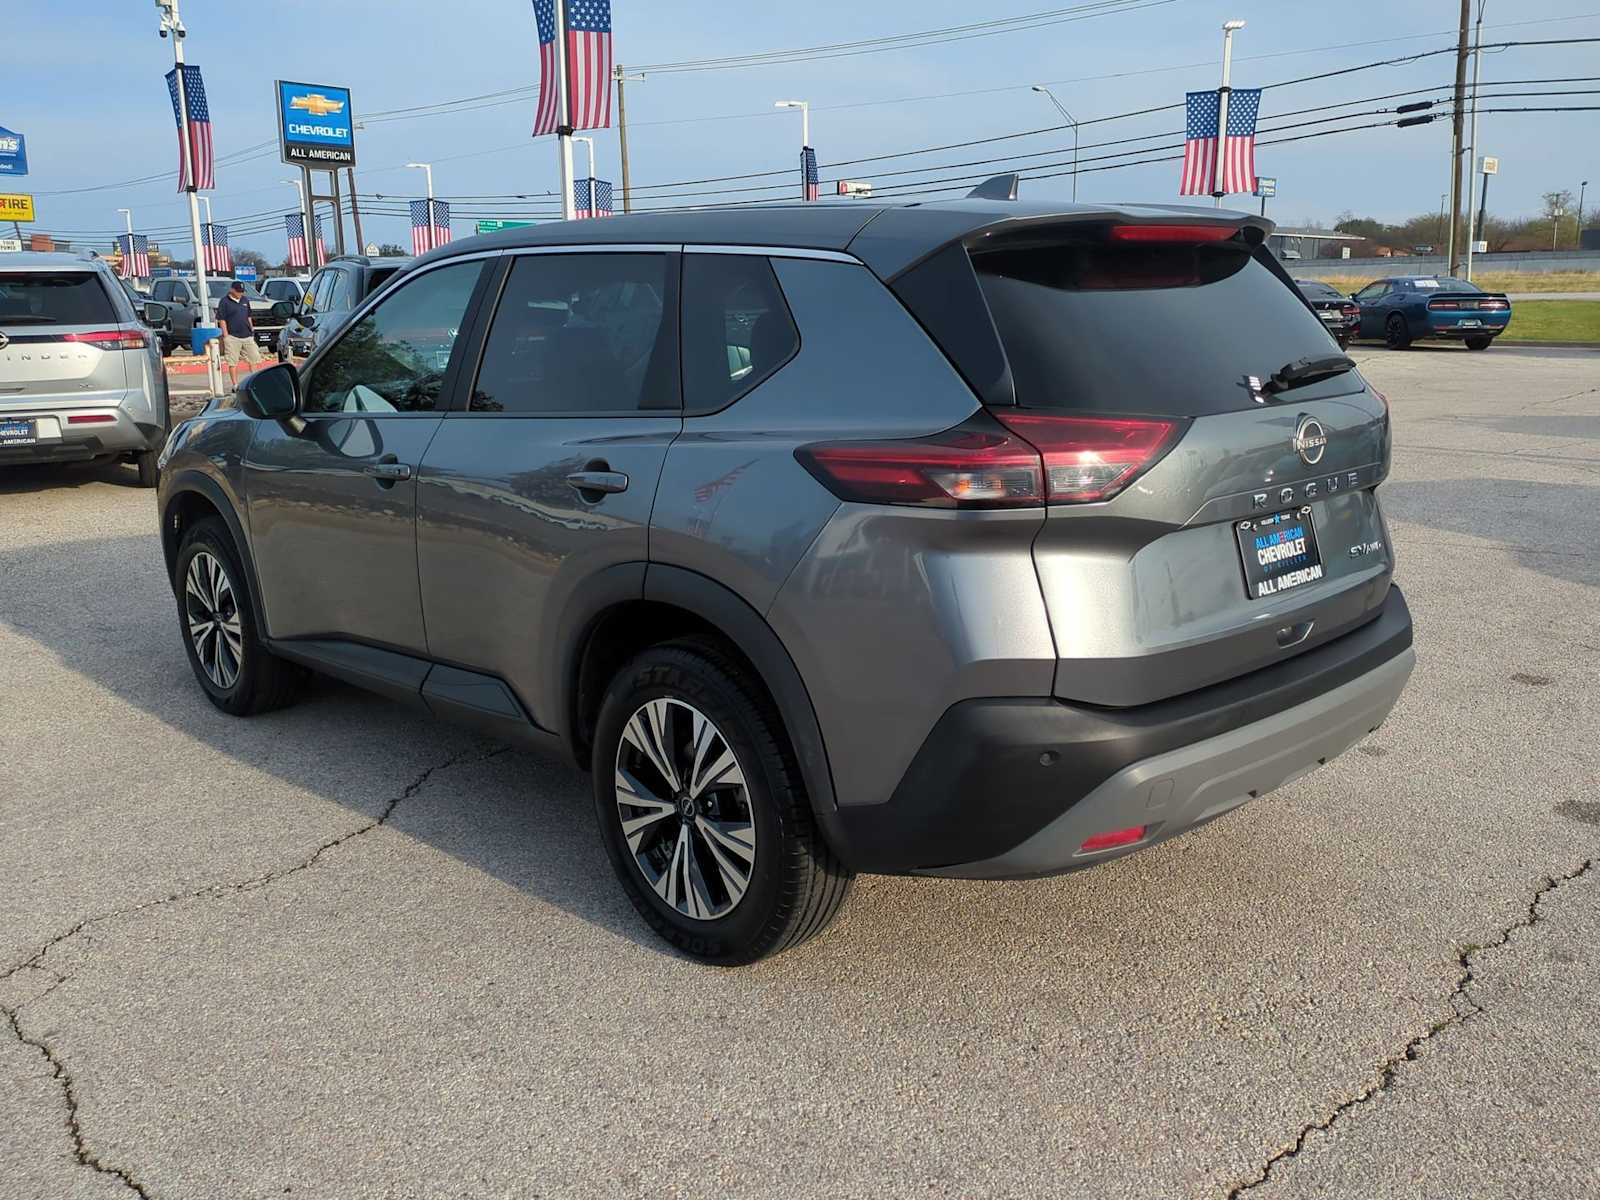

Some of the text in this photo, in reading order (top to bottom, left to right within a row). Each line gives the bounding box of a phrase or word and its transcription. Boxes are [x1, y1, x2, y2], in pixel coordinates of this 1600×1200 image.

[288, 123, 349, 138] CHEVROLET
[290, 148, 352, 161] ALL AMERICAN
[1297, 436, 1328, 451] NISSAN
[1253, 472, 1358, 510] ROGUE
[1255, 526, 1304, 550] ALL AMERICAN
[1257, 538, 1306, 565] CHEVROLET
[1258, 564, 1323, 597] ALL AMERICAN
